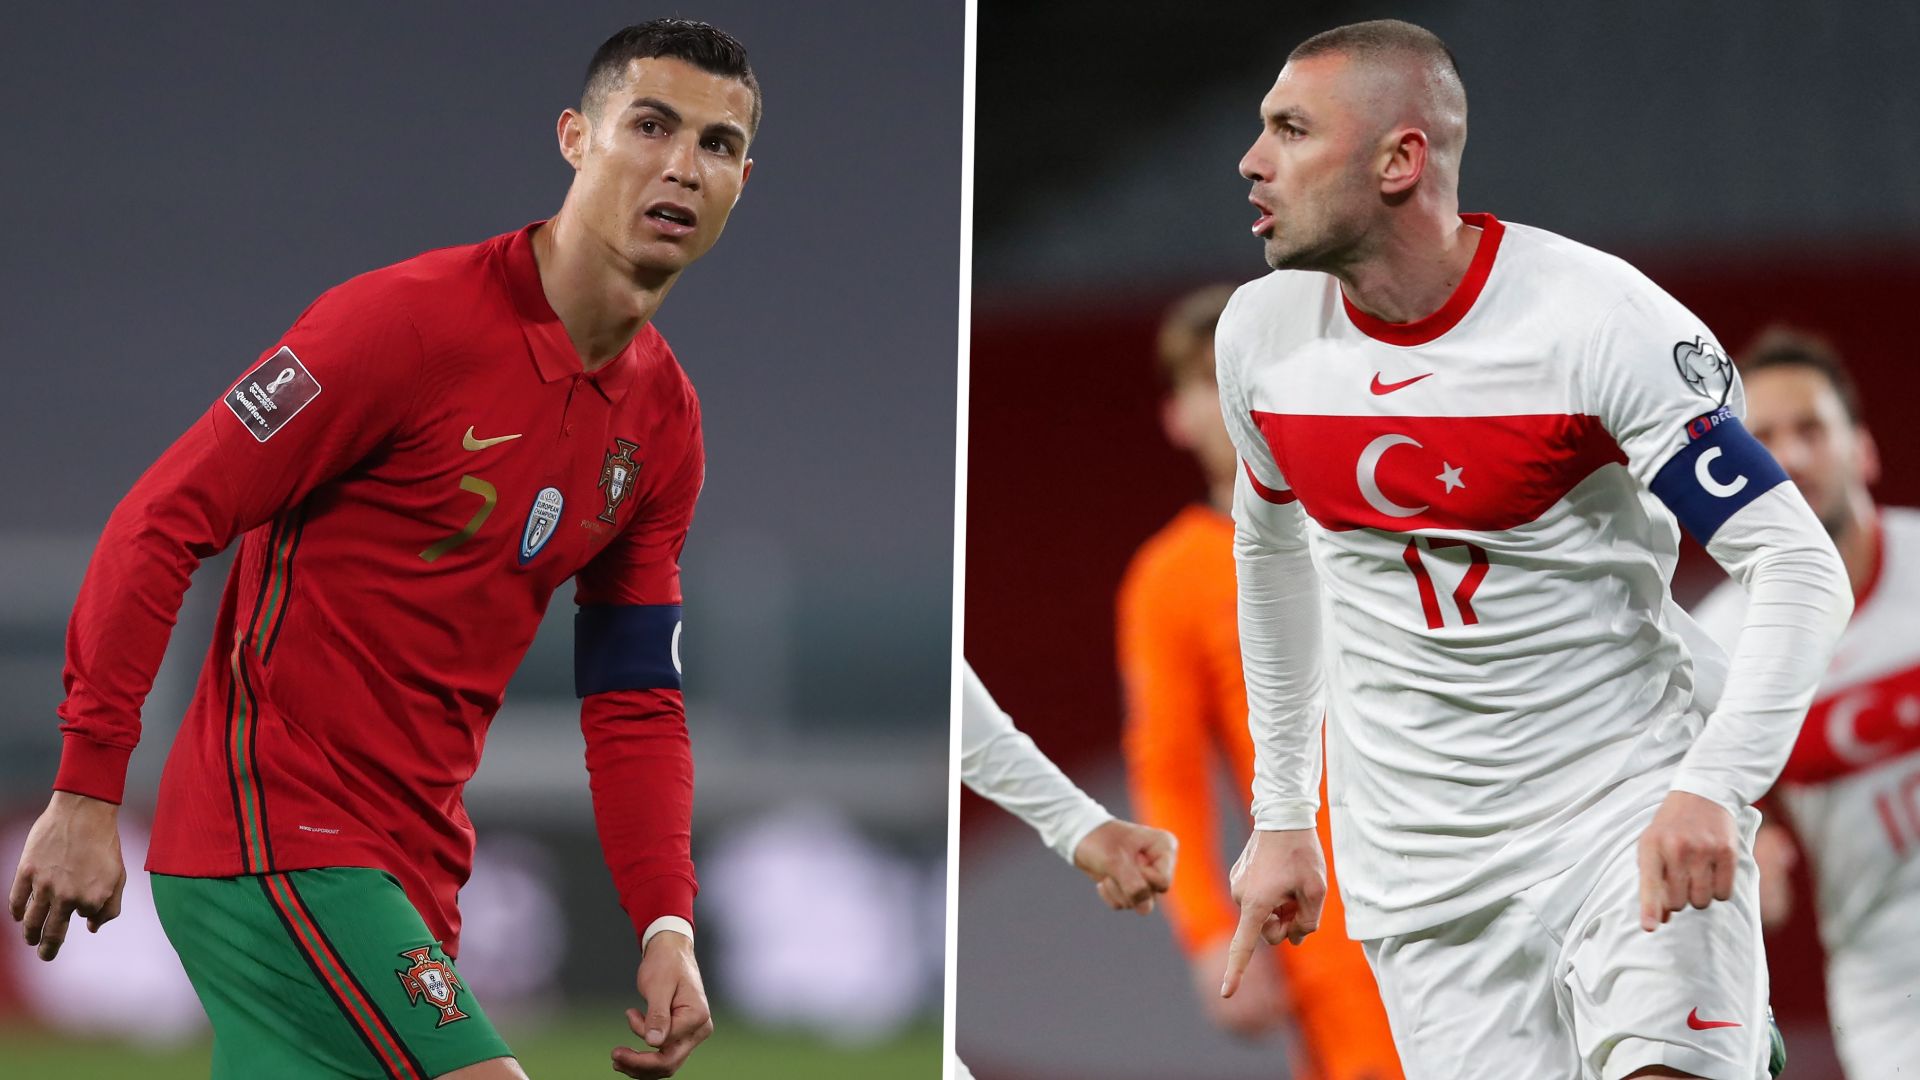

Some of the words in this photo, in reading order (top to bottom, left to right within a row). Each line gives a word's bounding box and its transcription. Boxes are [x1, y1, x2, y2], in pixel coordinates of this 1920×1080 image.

[236, 391, 266, 425] Qualifiers
[1695, 446, 1749, 498] C
[418, 474, 497, 564] 7
[534, 508, 557, 520] CHAMPIONS
[536, 501, 560, 513] EUROPEAN
[1402, 535, 1490, 630] 17
